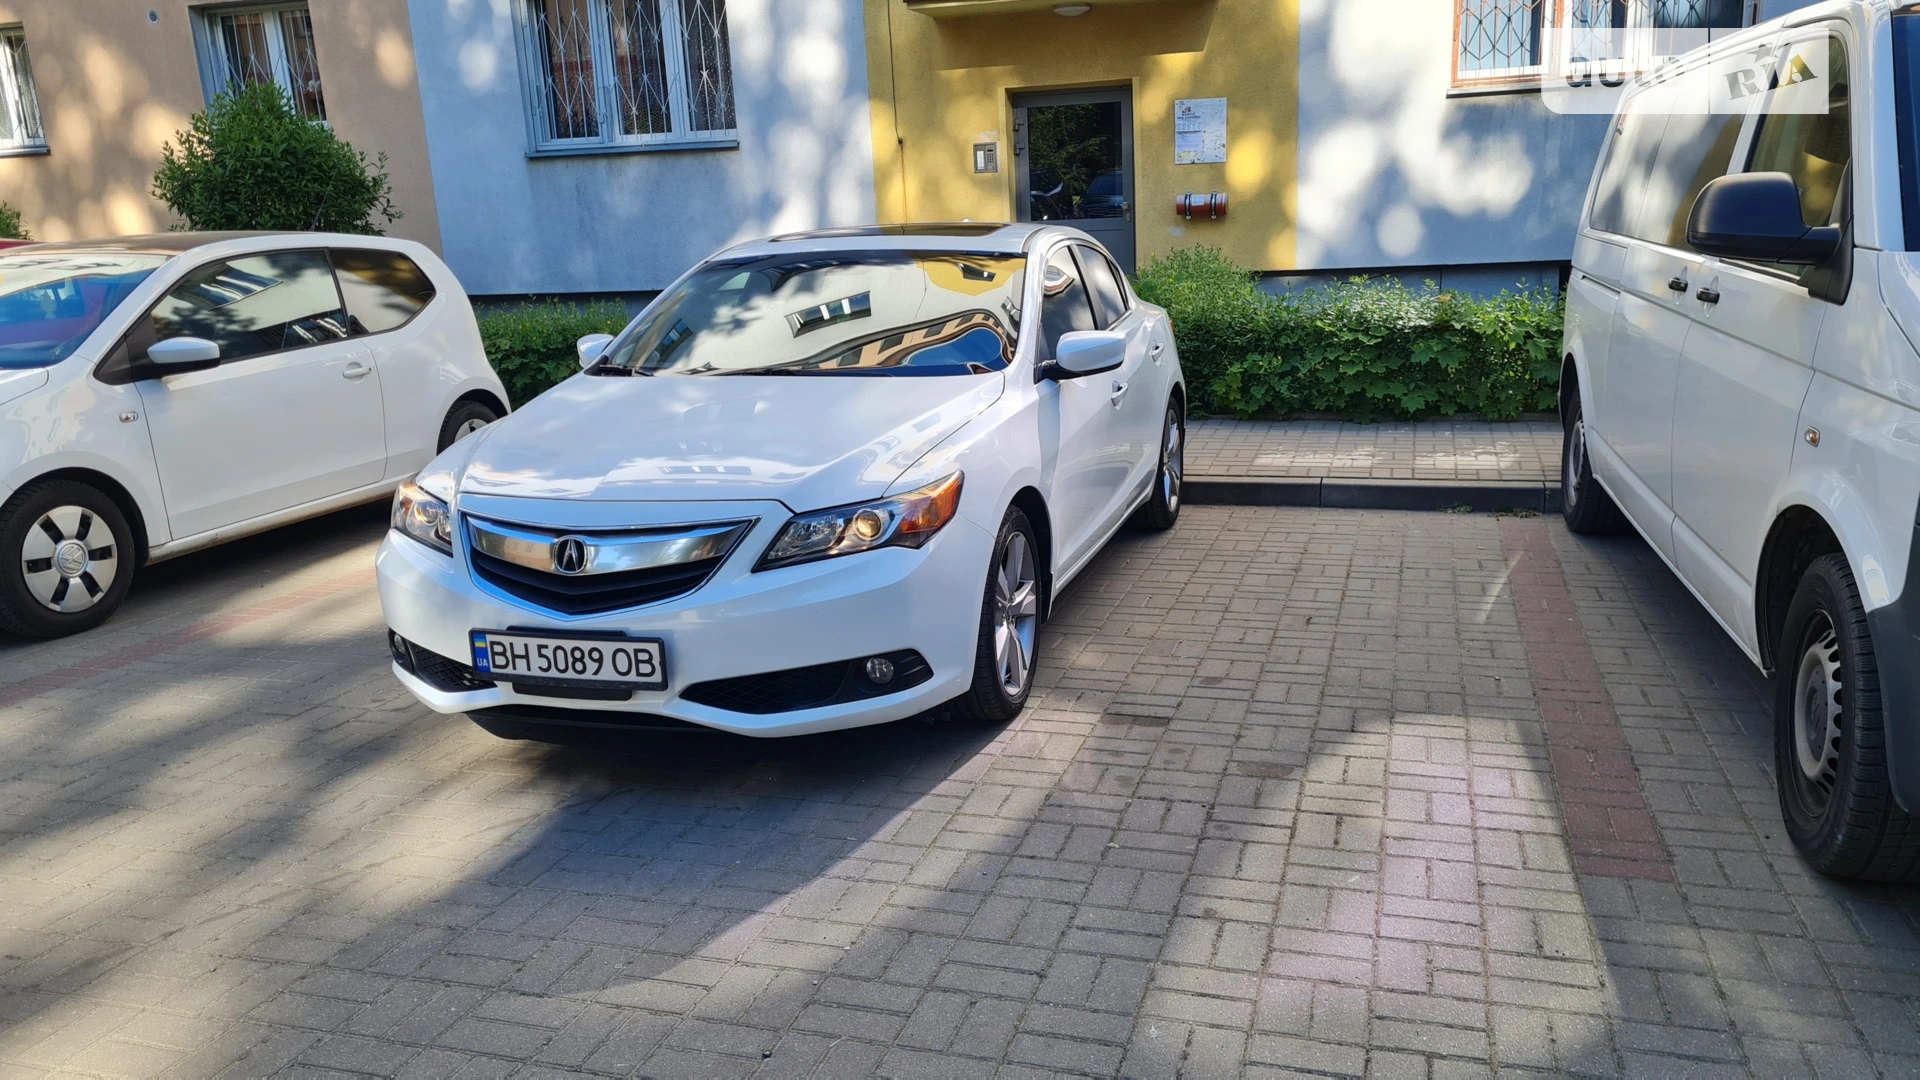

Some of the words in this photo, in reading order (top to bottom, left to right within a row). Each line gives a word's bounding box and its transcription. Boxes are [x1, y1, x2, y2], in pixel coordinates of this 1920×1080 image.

[476, 657, 489, 667] UA
[489, 641, 531, 671] BH
[537, 644, 604, 676] 5089
[611, 647, 656, 678] OB
